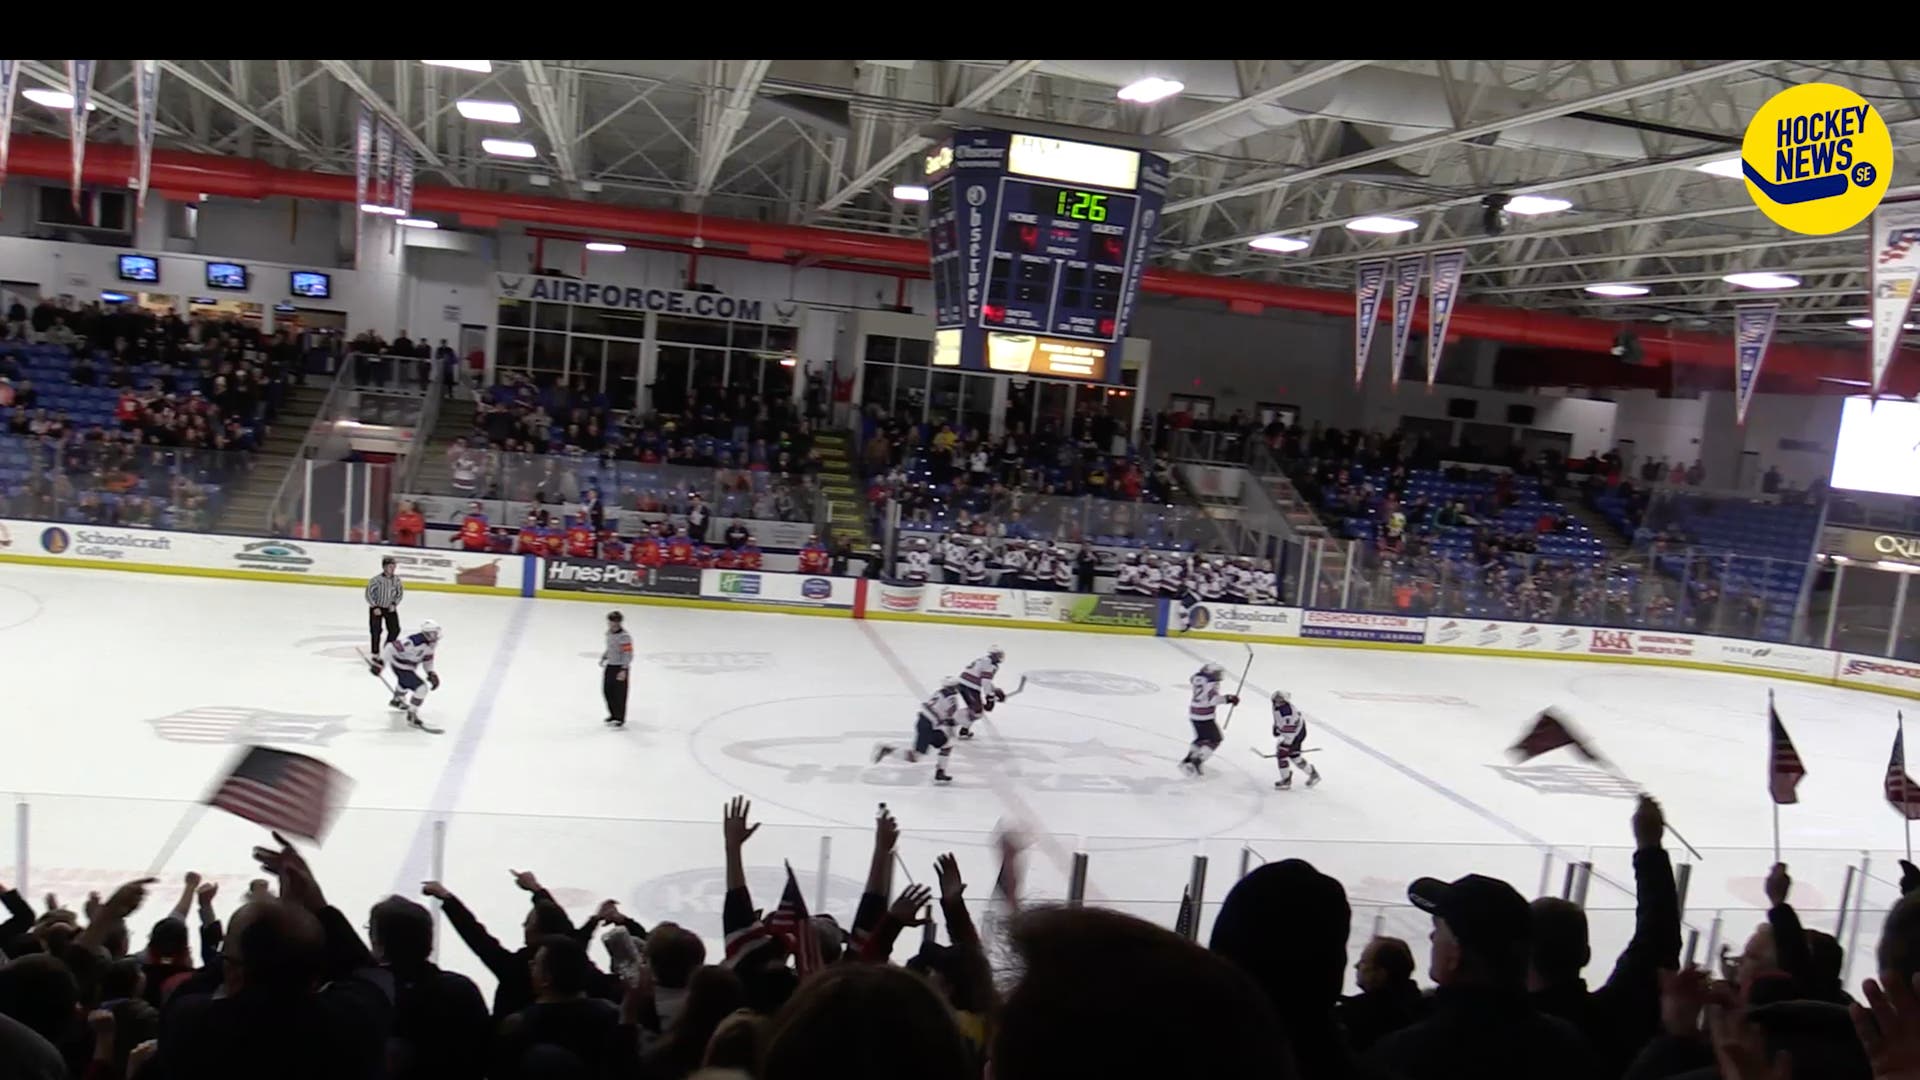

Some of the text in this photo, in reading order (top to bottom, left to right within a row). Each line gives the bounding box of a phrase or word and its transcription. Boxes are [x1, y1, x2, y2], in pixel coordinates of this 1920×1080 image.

[1056, 190, 1109, 223] 1:26
[530, 277, 762, 322] AIRFORCE.COM
[75, 529, 171, 551] Schoolcraft
[548, 560, 602, 582] Hines
